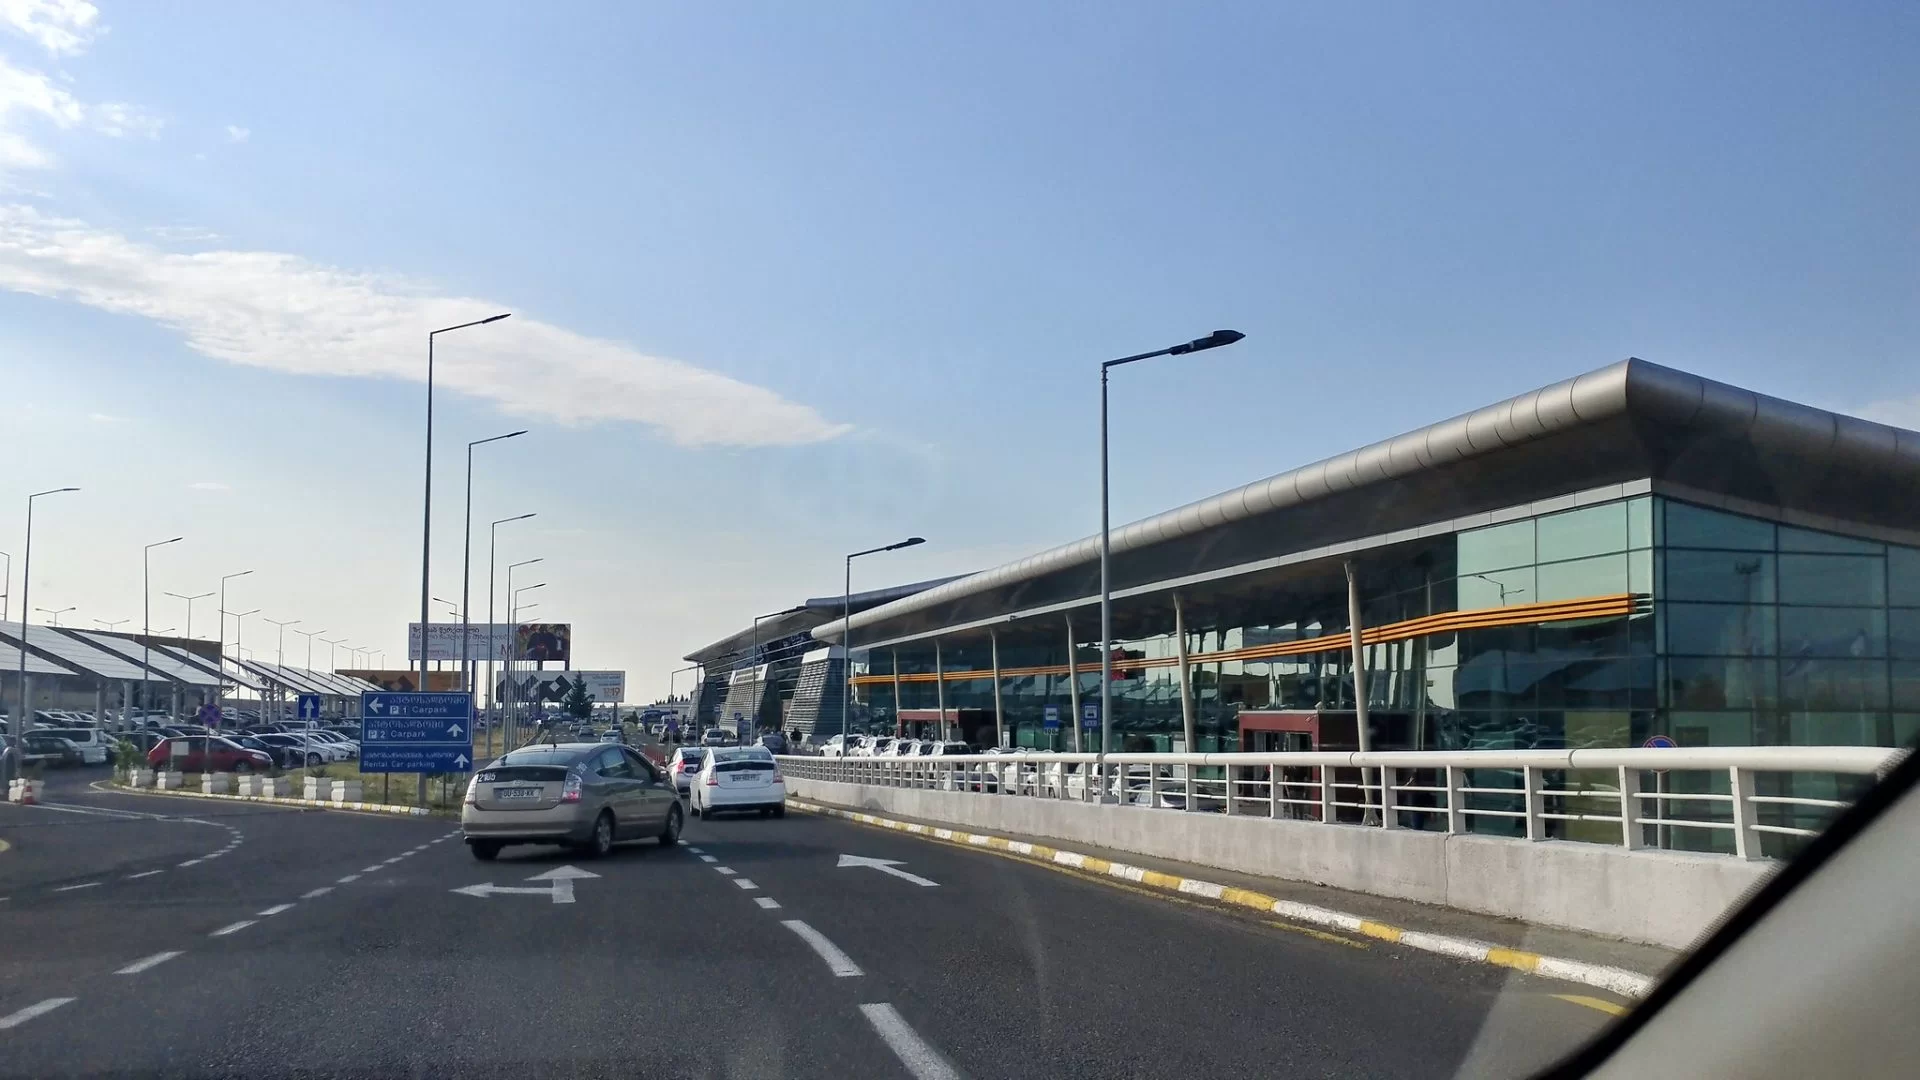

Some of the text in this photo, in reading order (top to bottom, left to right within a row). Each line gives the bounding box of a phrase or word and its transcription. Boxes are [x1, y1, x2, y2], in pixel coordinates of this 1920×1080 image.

[411, 706, 448, 715] Carpark
[390, 730, 426, 738] Carpark
[363, 760, 435, 769] Rental Car parking
